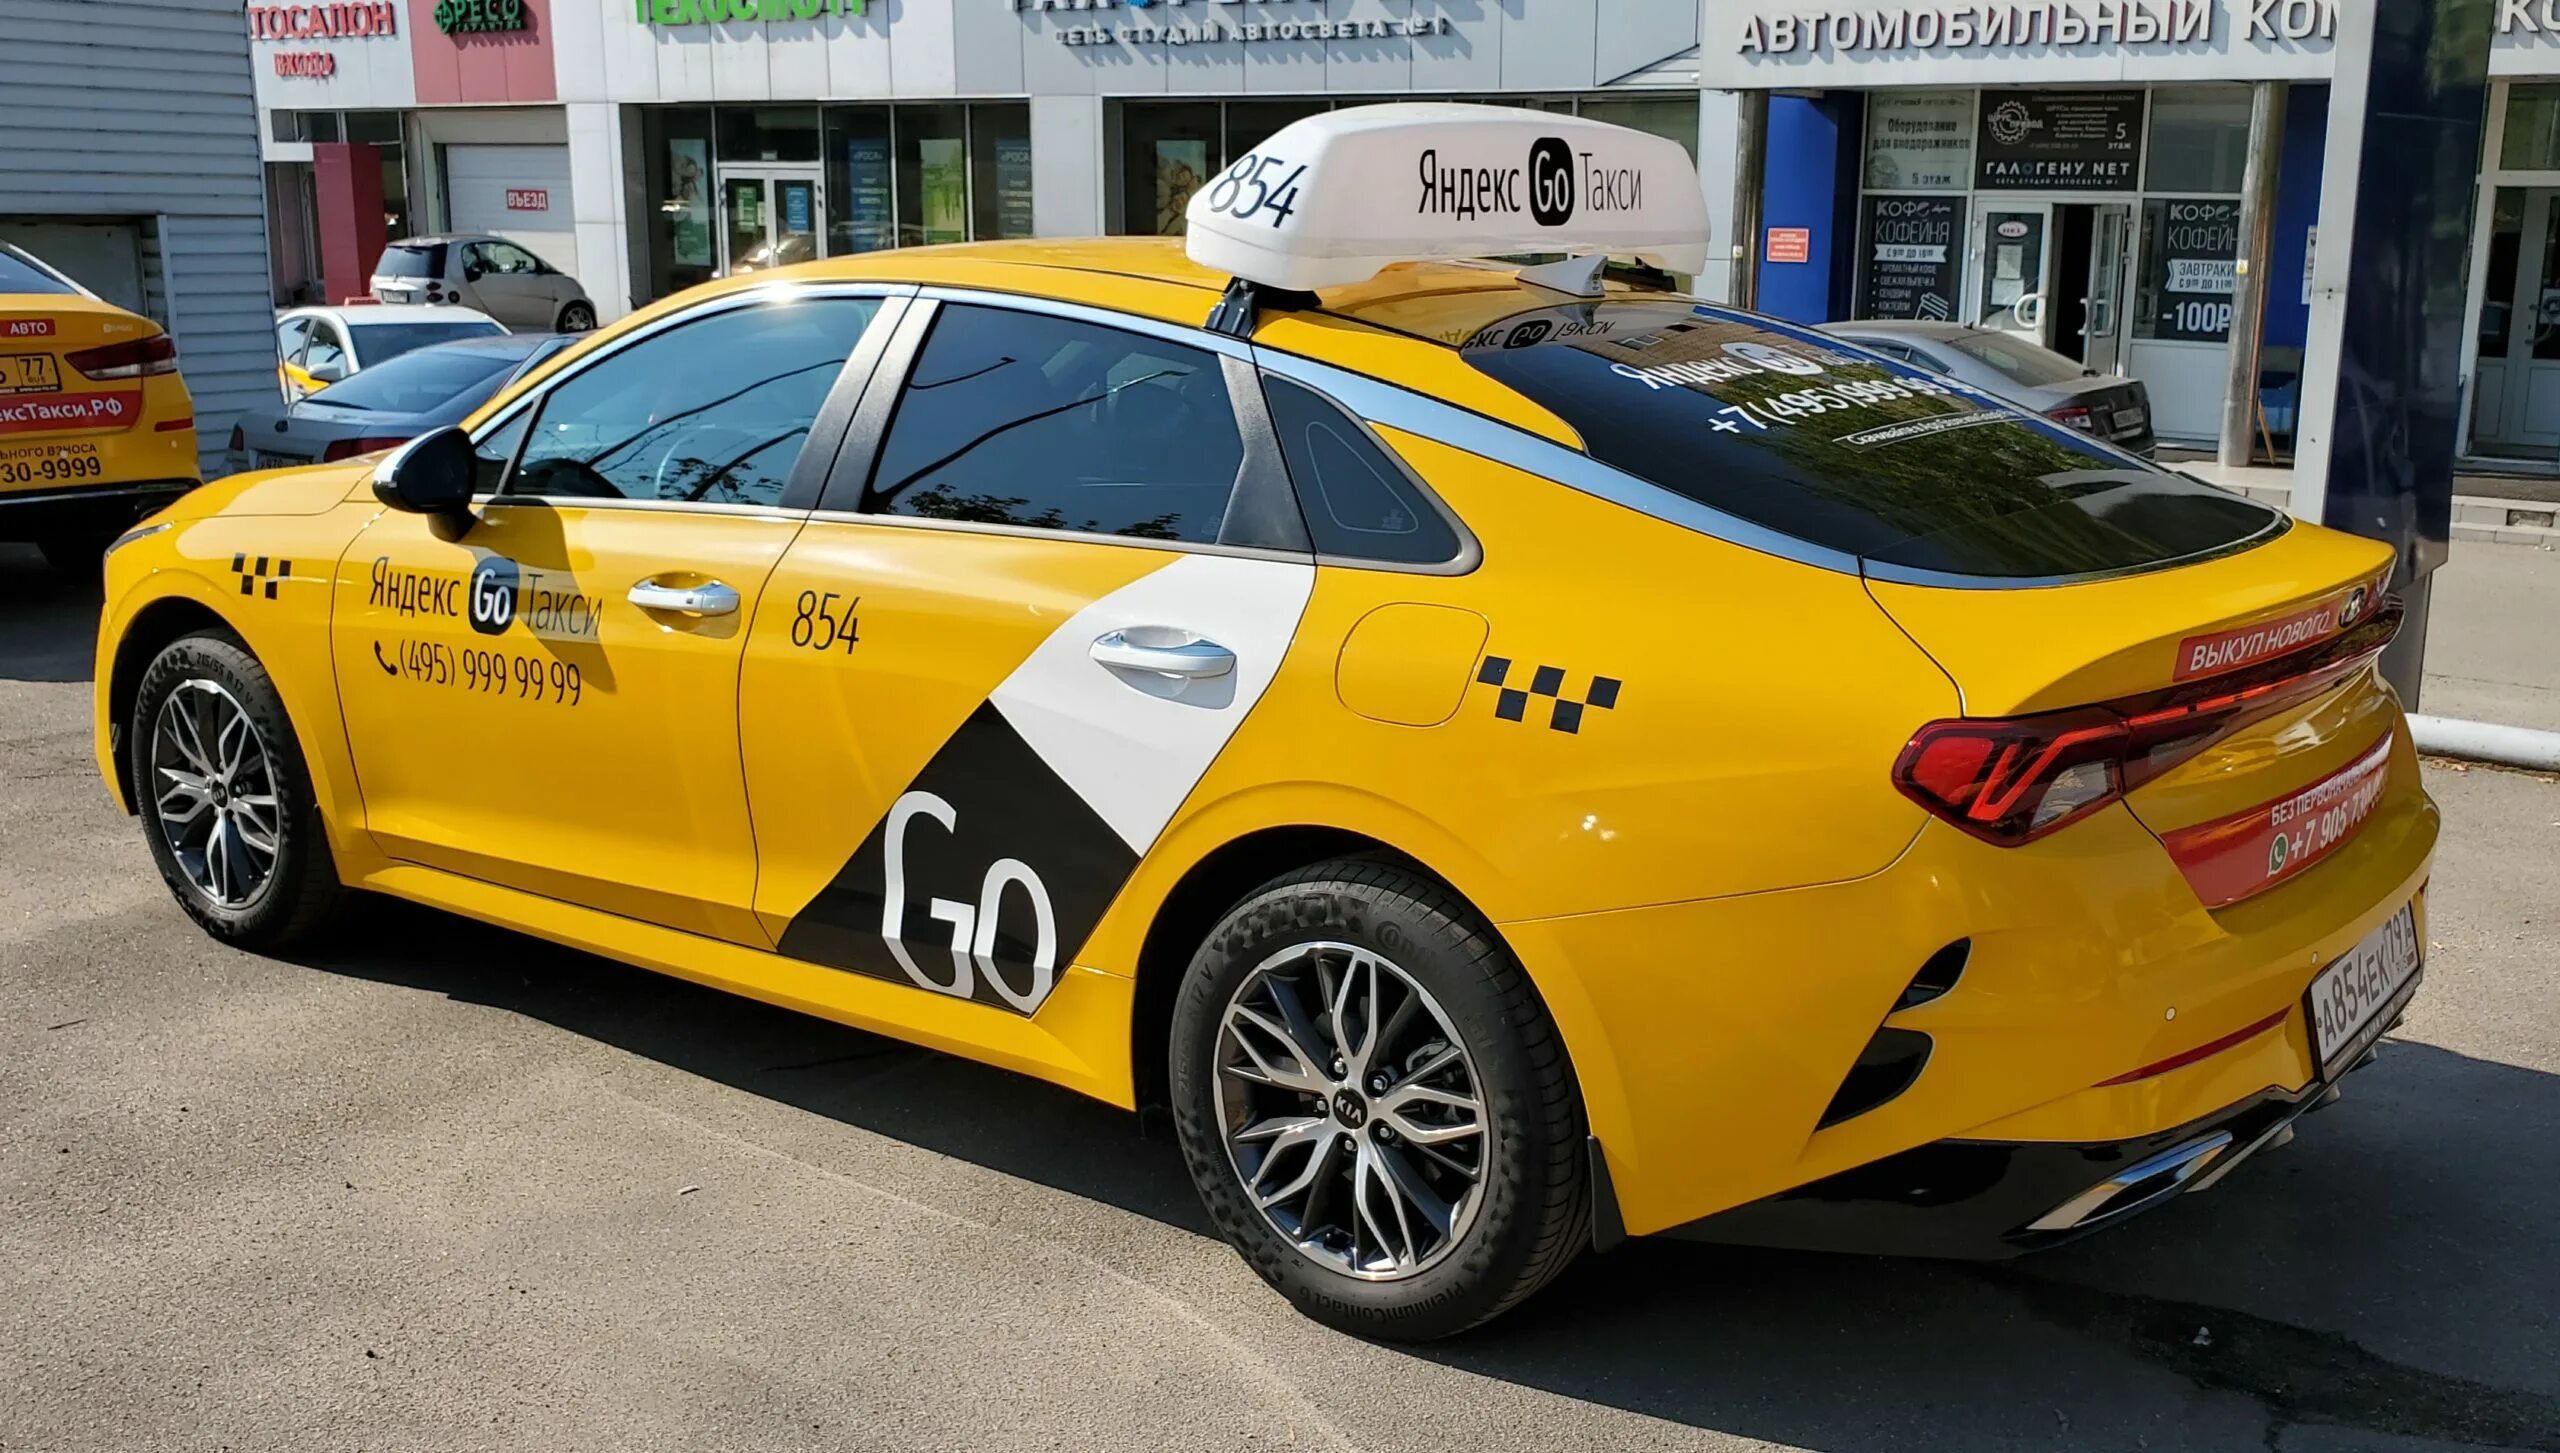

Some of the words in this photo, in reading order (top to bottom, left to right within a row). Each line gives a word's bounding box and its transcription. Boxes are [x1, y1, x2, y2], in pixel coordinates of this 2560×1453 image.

[1055, 26, 1110, 45] СЕТЬ
[1120, 19, 1219, 45] СТУДИЙ
[1228, 19, 1387, 41] АВТОСВЕТА
[1737, 0, 2212, 54] АВТОМОБИЛЬНЫЙ
[1887, 118, 1958, 134] Оборудование
[2115, 122, 2127, 140] 5
[1922, 175, 1951, 185] этаж
[2092, 162, 2130, 175] NET
[1208, 154, 1309, 230] 854
[1418, 149, 1521, 221] Яндекс
[1534, 150, 1569, 214] Go
[1579, 152, 1642, 212] Такси
[508, 191, 547, 211] ВЪЕЗД
[1874, 219, 1950, 244] КОФЕЙНЯ
[2179, 263, 2236, 277] ЗАВТРАКИ
[2200, 279, 2213, 289] ДО
[10, 321, 47, 335] АВТО
[20, 358, 44, 376] 77
[1610, 356, 1764, 390] Яндекс
[0, 456, 101, 483] 30-9999
[369, 556, 461, 618] Яндекс
[474, 568, 511, 625] Go
[526, 573, 603, 637] Такси
[791, 590, 861, 655] 854
[2190, 631, 2264, 672] ВЫКУП
[2264, 609, 2331, 651] НОВОГО
[400, 638, 456, 687] (495)
[463, 649, 507, 695] 999
[514, 656, 544, 700] 99
[551, 661, 582, 706] 99
[2271, 799, 2295, 827] БЕЗ
[2291, 818, 2317, 859] +7
[2320, 800, 2348, 849] 905
[882, 790, 1058, 1017] Go
[2322, 943, 2391, 1049] А854ЕК
[2384, 906, 2411, 963] 797
[1314, 1281, 1466, 1326] PremiumContact
